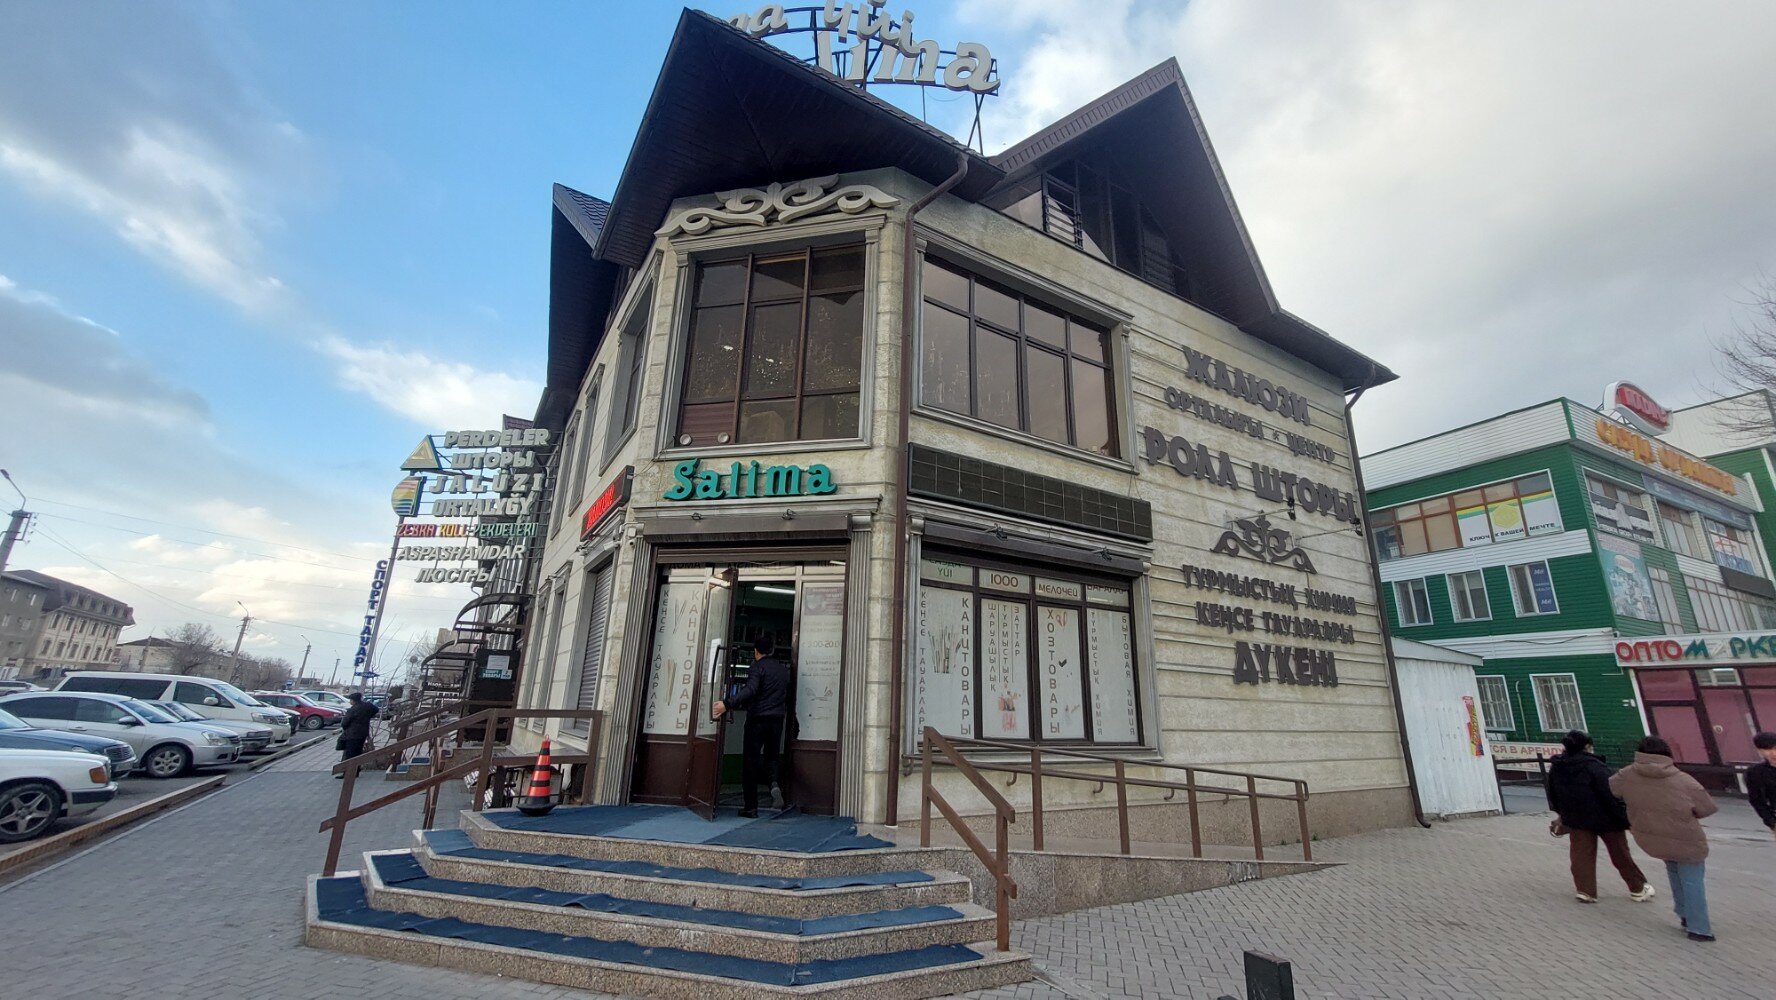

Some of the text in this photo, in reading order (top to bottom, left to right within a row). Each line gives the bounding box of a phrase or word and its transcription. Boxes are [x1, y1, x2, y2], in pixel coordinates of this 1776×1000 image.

[1181, 345, 1311, 426] ЖАЛЮЗИ
[444, 428, 550, 448] PERDELER
[1286, 431, 1336, 465] ЦЕНТР
[451, 450, 537, 470] ШТОРЫ
[663, 458, 838, 500] Salima
[1144, 426, 1356, 524] РОЛЛ ШТОРЫ
[397, 524, 437, 537] ZEBRA
[1529, 522, 1556, 531] МЕЧТЕ
[397, 545, 527, 561] ASPASHAMDAR
[366, 560, 388, 610] СПОРТ
[415, 567, 498, 583] ЛЮСТРЫ
[990, 573, 1018, 588] 1000
[354, 615, 376, 667] ТАУАР
[675, 590, 700, 730] КАНЦТОВАРЫ
[1121, 616, 1131, 679] БЫТОВАЯ
[961, 597, 971, 735] КАНЦТОВАРЫ
[1047, 608, 1060, 734] ХОЗТОВАРЫ
[1510, 746, 1517, 754] В
